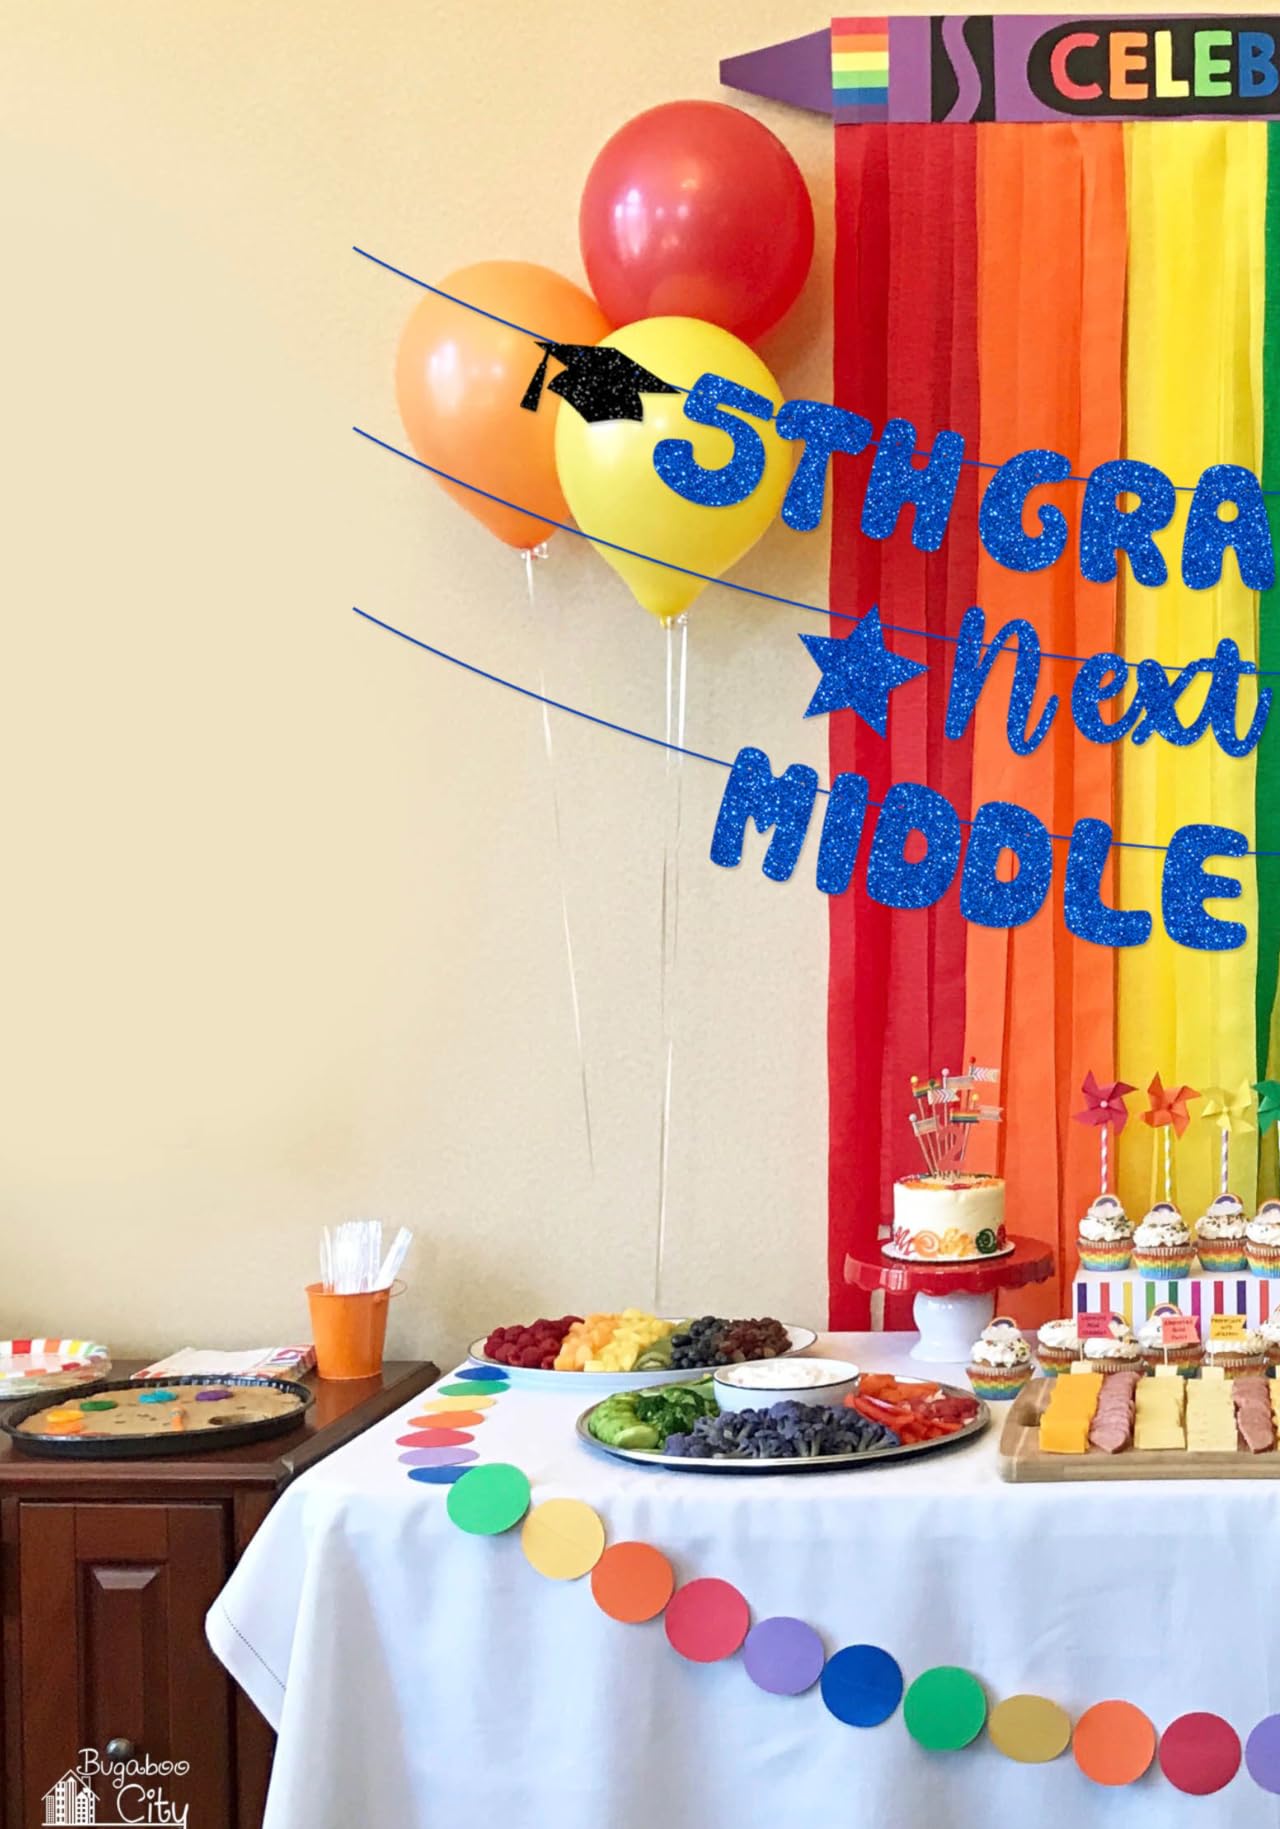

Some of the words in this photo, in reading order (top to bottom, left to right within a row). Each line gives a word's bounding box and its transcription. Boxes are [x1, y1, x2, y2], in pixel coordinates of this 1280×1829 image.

[653, 373, 966, 552] 5TH
[945, 606, 1273, 757] Next
[710, 747, 1249, 951] MIDDLE
